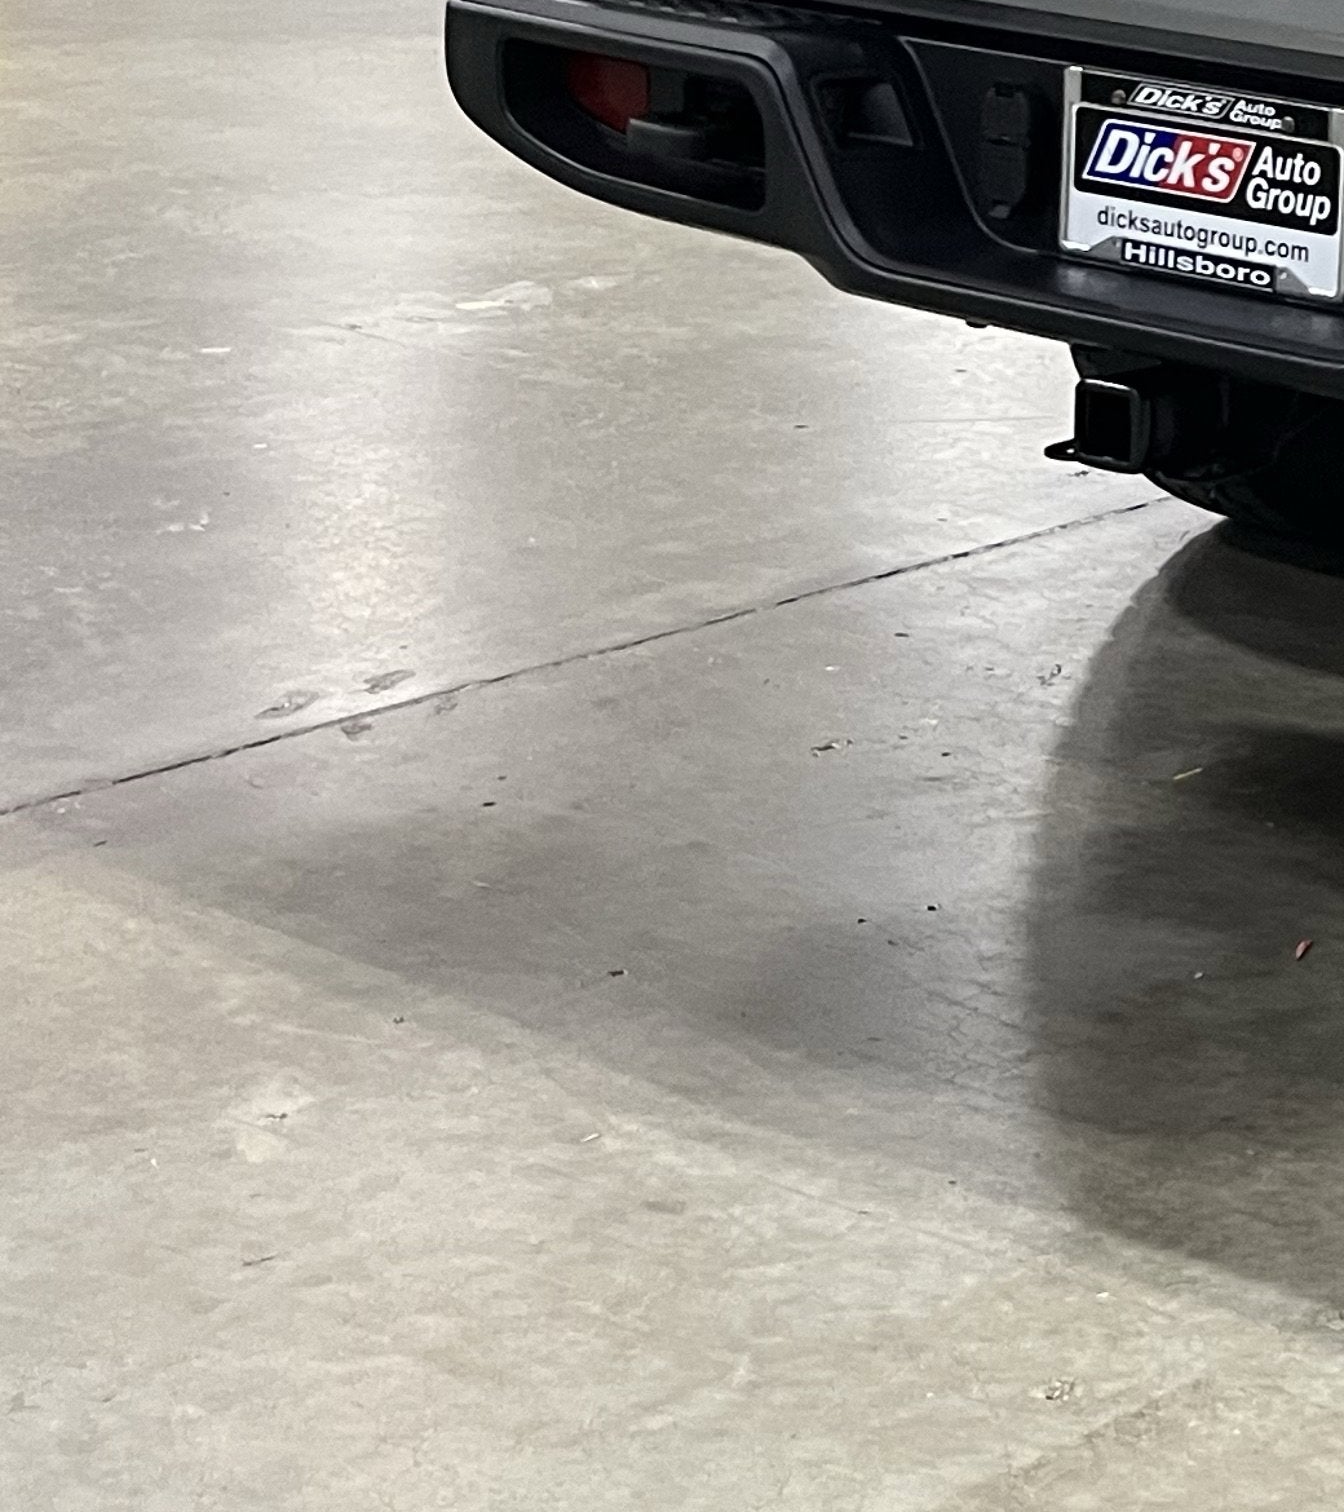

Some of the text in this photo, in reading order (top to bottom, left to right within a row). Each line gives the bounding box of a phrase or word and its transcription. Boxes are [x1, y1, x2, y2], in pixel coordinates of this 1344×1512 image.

[1134, 86, 1225, 117] Dick's
[1229, 110, 1282, 130] Group
[1234, 99, 1276, 117] Auto
[1094, 129, 1237, 194] Dick's
[1252, 145, 1322, 186] Auto
[1246, 179, 1332, 226] Group
[1097, 205, 1310, 263] dicksautogroup.com
[1123, 241, 1272, 287] Hillsboro
